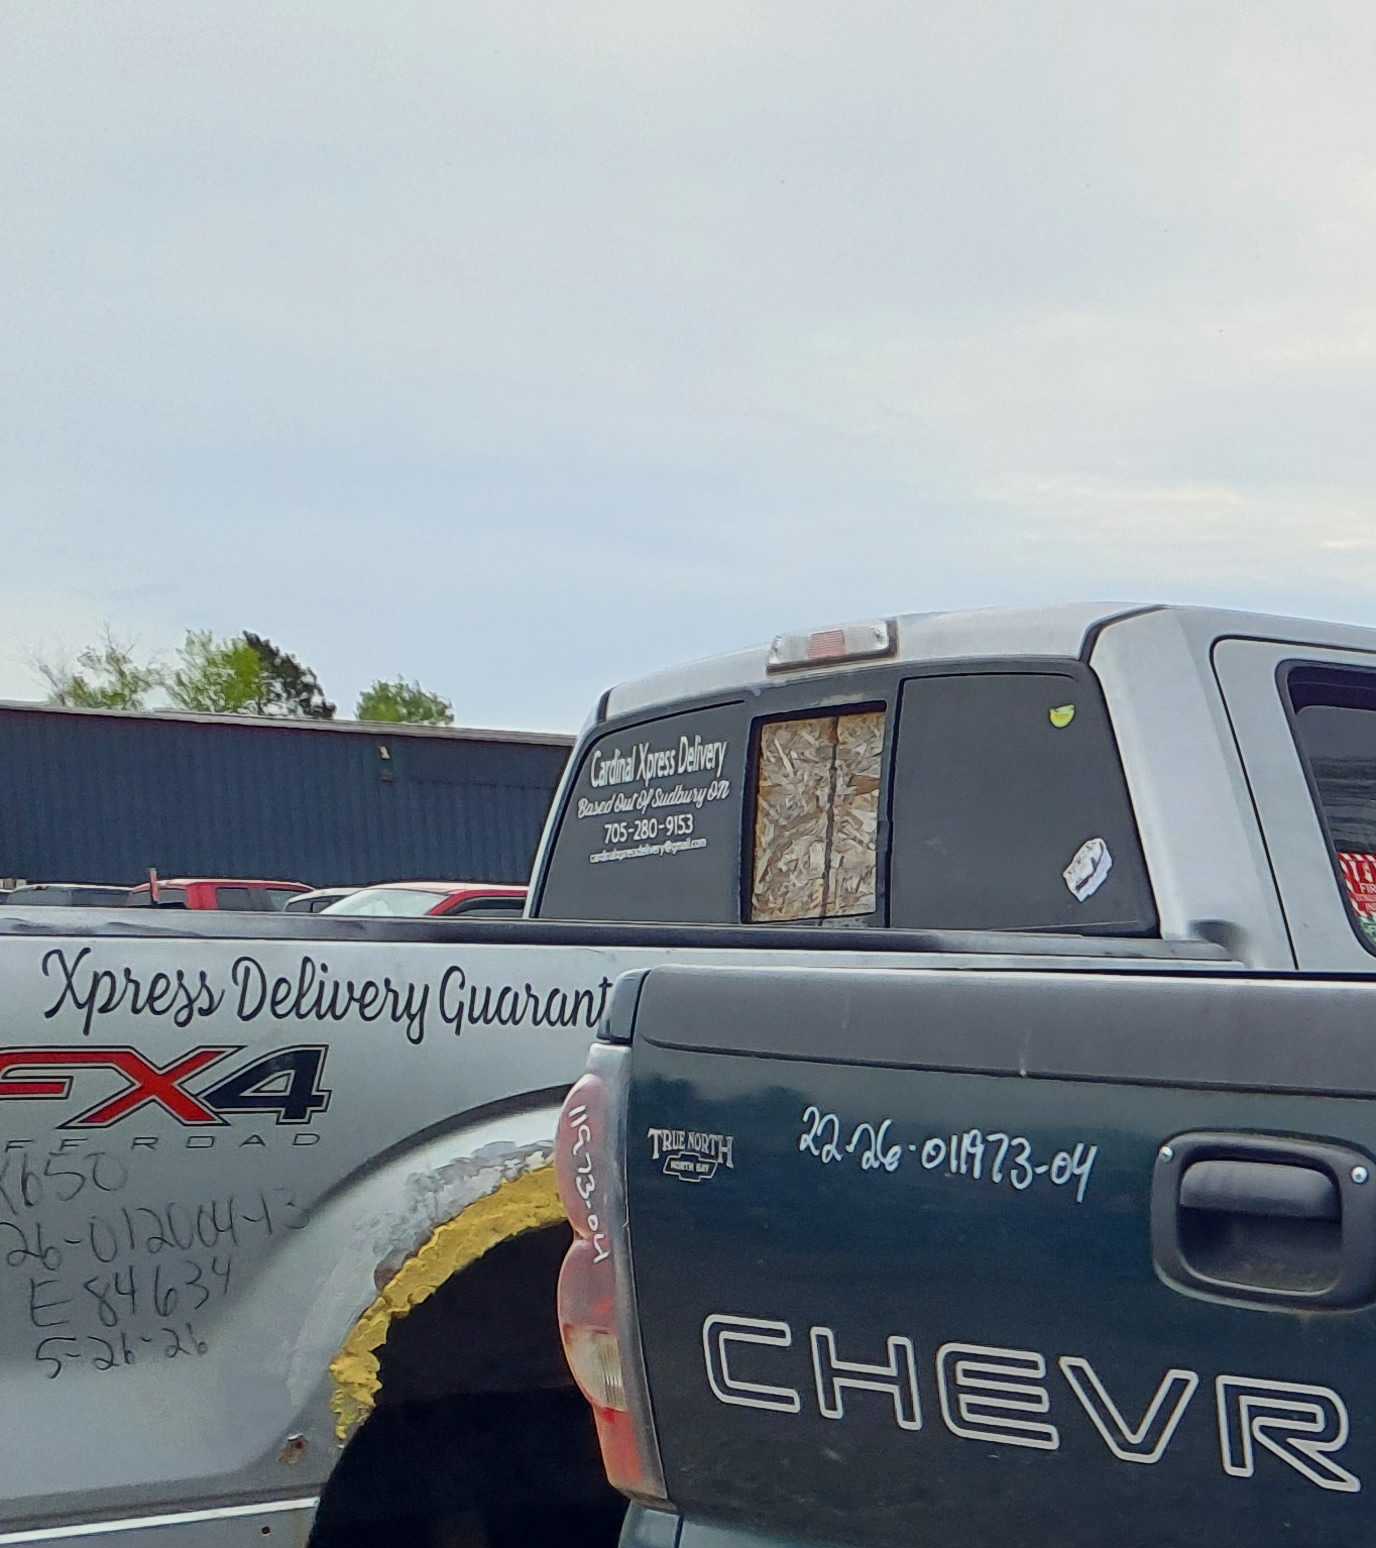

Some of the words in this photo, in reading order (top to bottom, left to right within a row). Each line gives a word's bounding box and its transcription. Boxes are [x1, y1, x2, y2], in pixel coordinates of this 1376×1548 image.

[590, 746, 637, 787] Cardinal
[636, 742, 676, 786] Xpress
[677, 735, 728, 778] Delivery
[578, 794, 616, 819] Based
[614, 792, 638, 812] Out
[651, 785, 708, 808] Sudbury
[604, 814, 694, 844] 705-280-9153
[41, 947, 224, 1036] Xpress
[231, 955, 430, 1045] Delivery
[0, 1044, 332, 1129] FX4
[131, 1133, 321, 1150] ROAD
[648, 1127, 685, 1159] TRUE
[687, 1131, 734, 1168] NORTH
